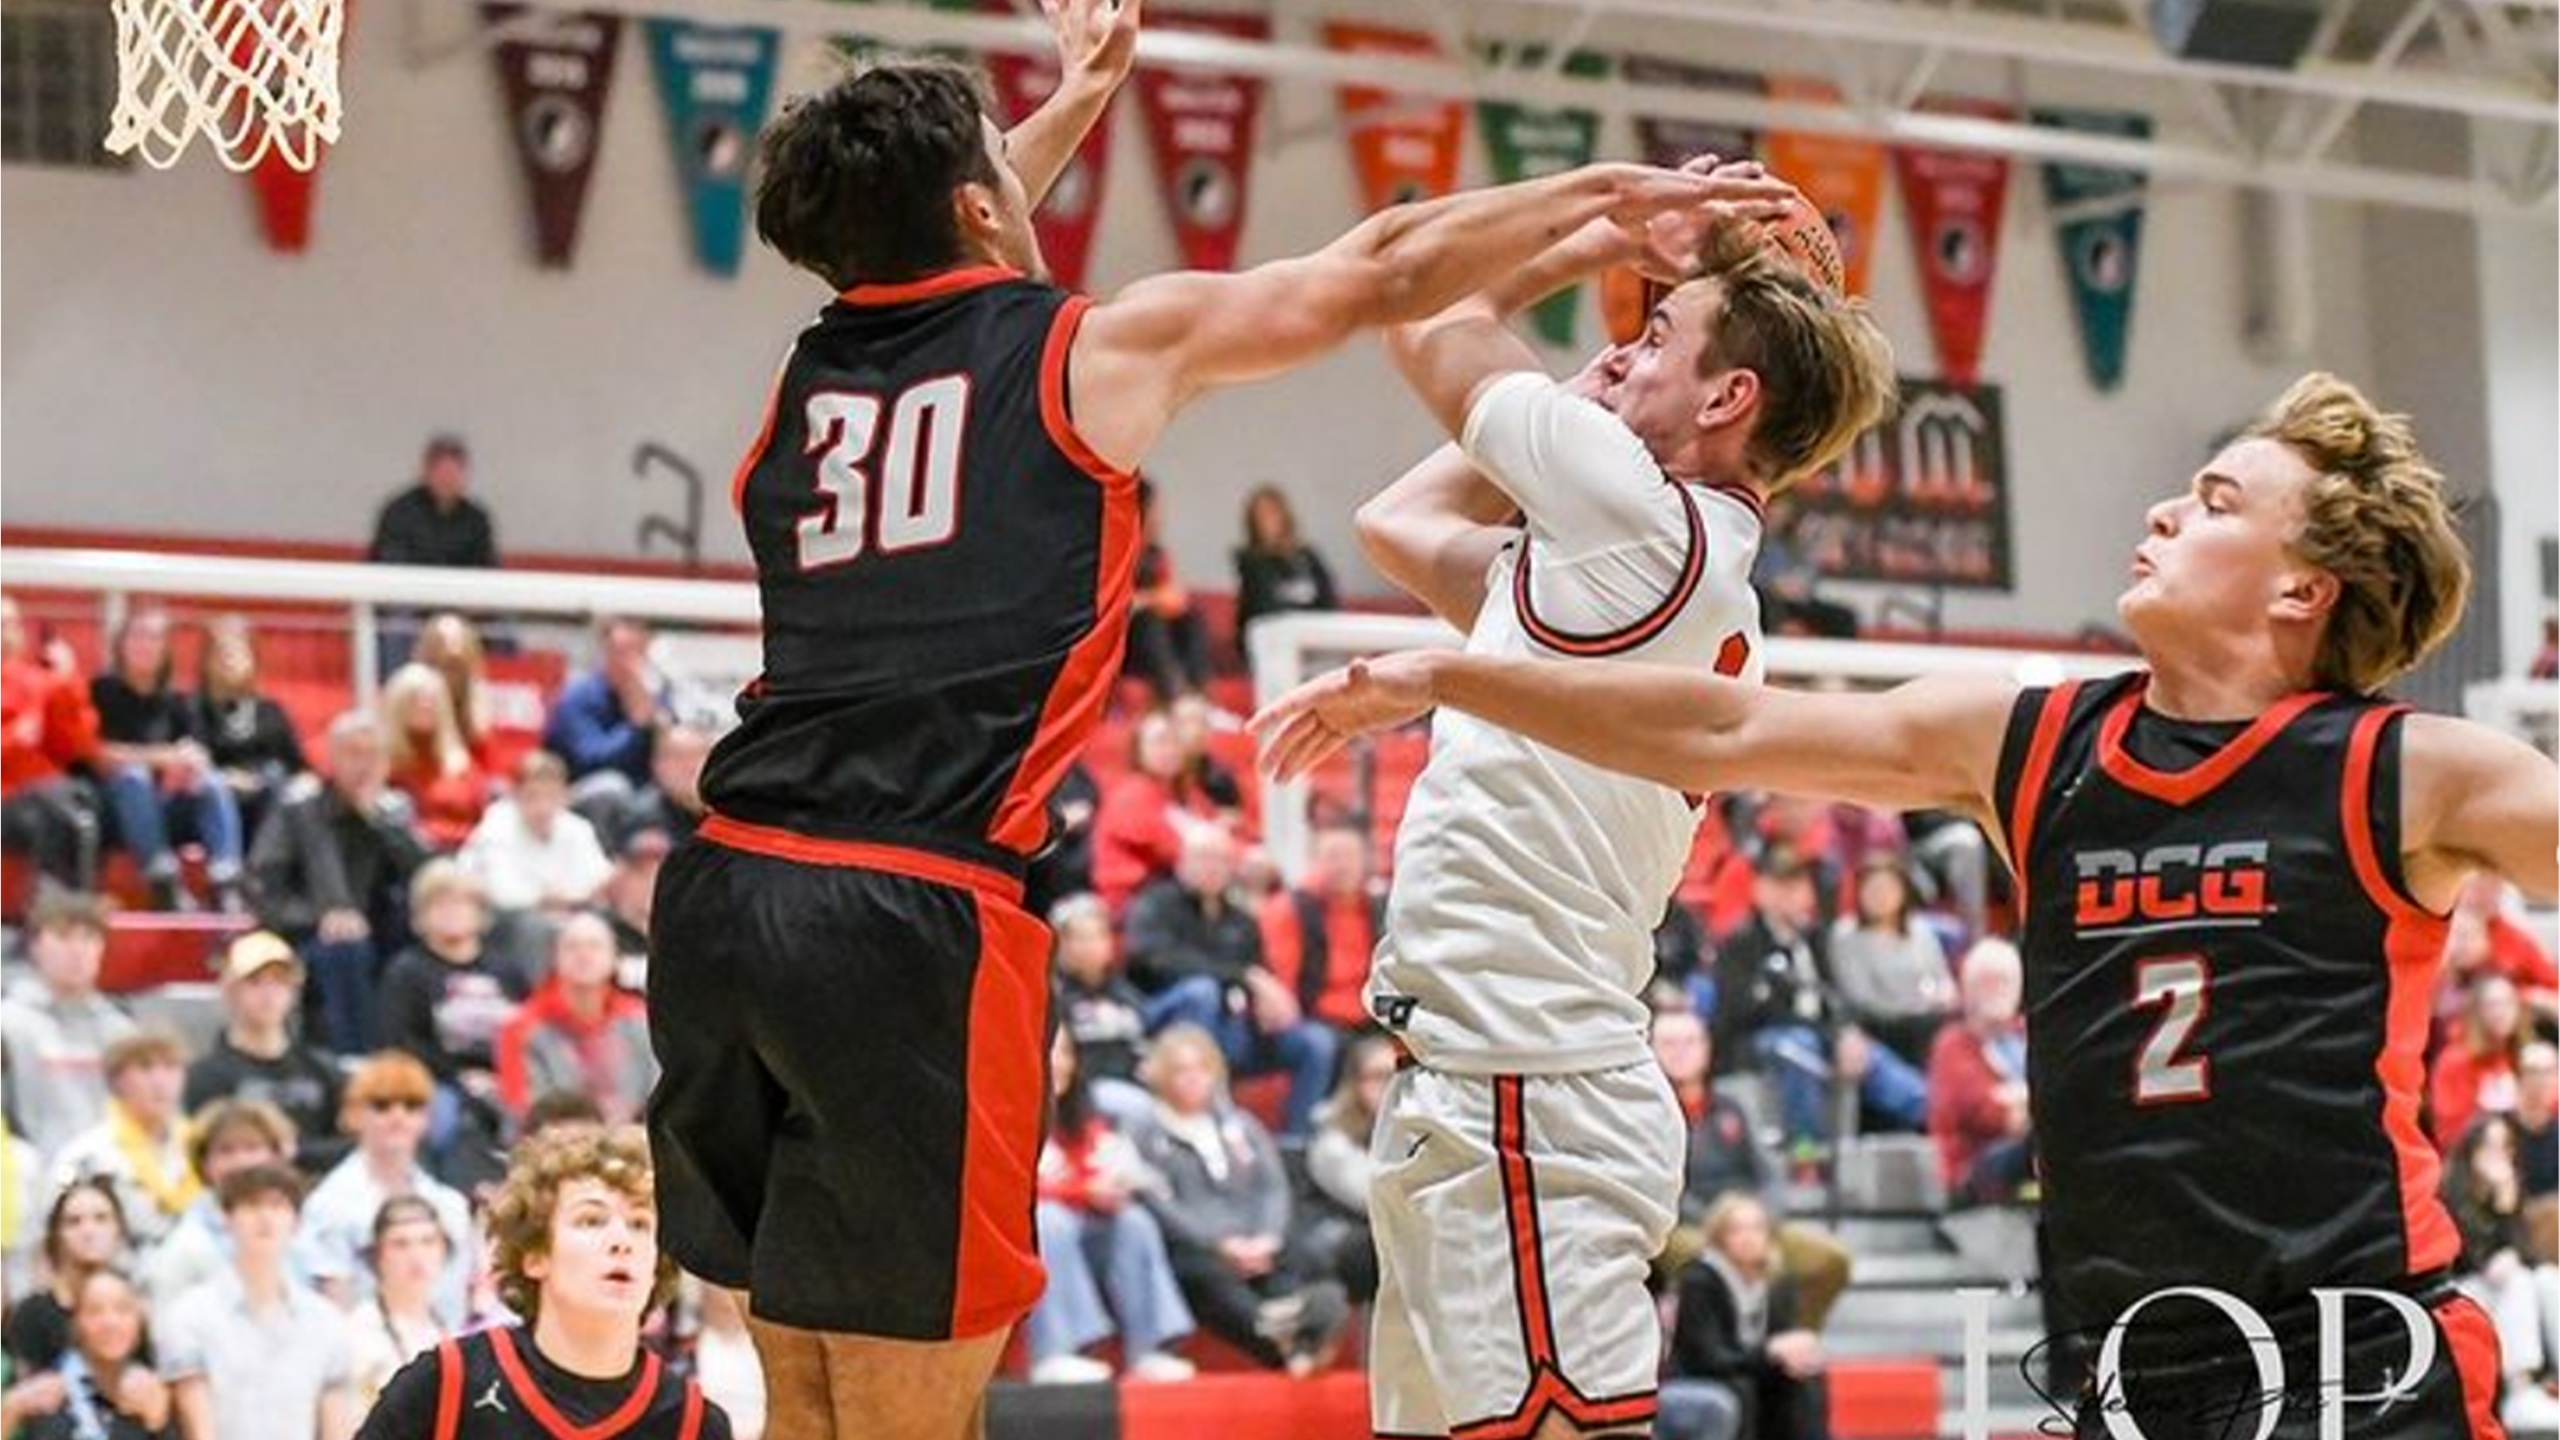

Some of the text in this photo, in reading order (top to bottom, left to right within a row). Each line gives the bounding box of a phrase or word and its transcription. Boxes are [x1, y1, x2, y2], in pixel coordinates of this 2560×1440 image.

[797, 372, 973, 571] 30
[2075, 842, 2269, 924] DCG
[2133, 954, 2210, 1106] 2
